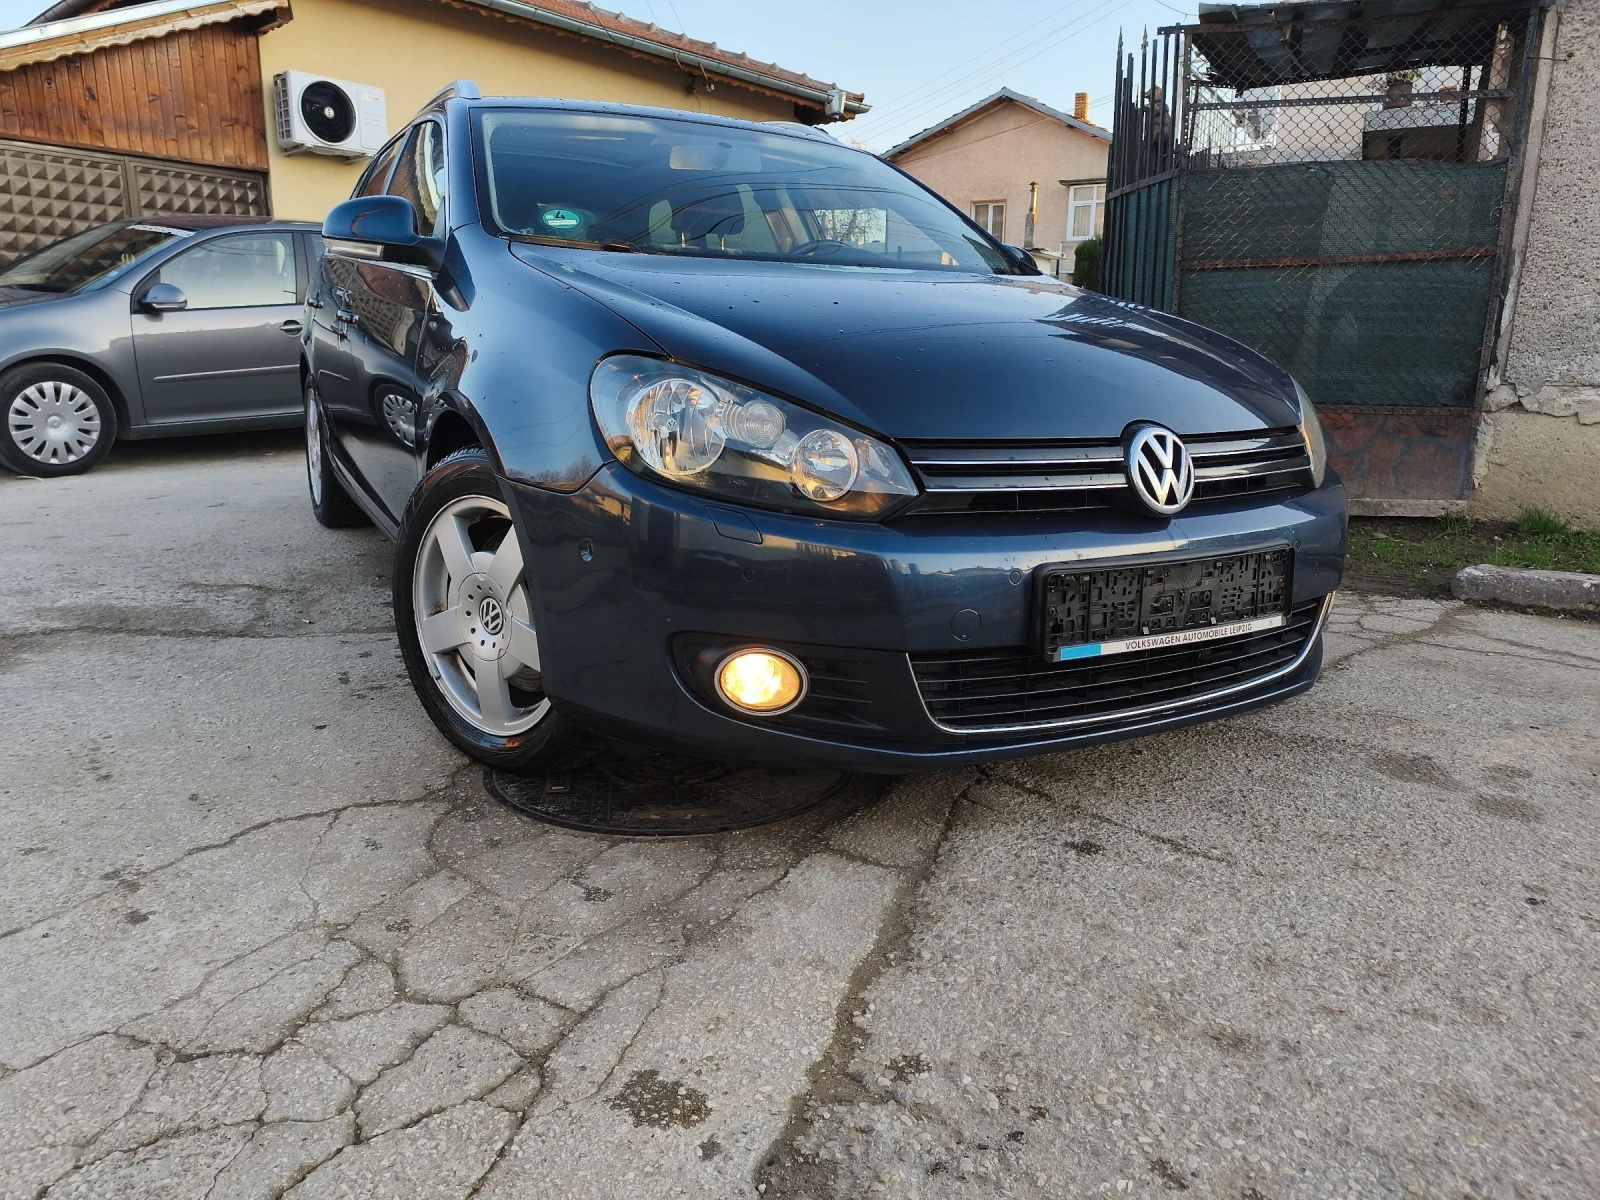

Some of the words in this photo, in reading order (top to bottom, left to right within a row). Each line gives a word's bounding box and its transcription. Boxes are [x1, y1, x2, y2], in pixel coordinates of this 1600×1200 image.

[555, 210, 565, 219] 4
[1129, 427, 1195, 515] VW
[479, 596, 504, 635] VW
[1125, 636, 1180, 650] VOLKSWAGEN
[1183, 629, 1228, 642] AUTOMOBILE
[1229, 623, 1253, 635] LEIPZIG
